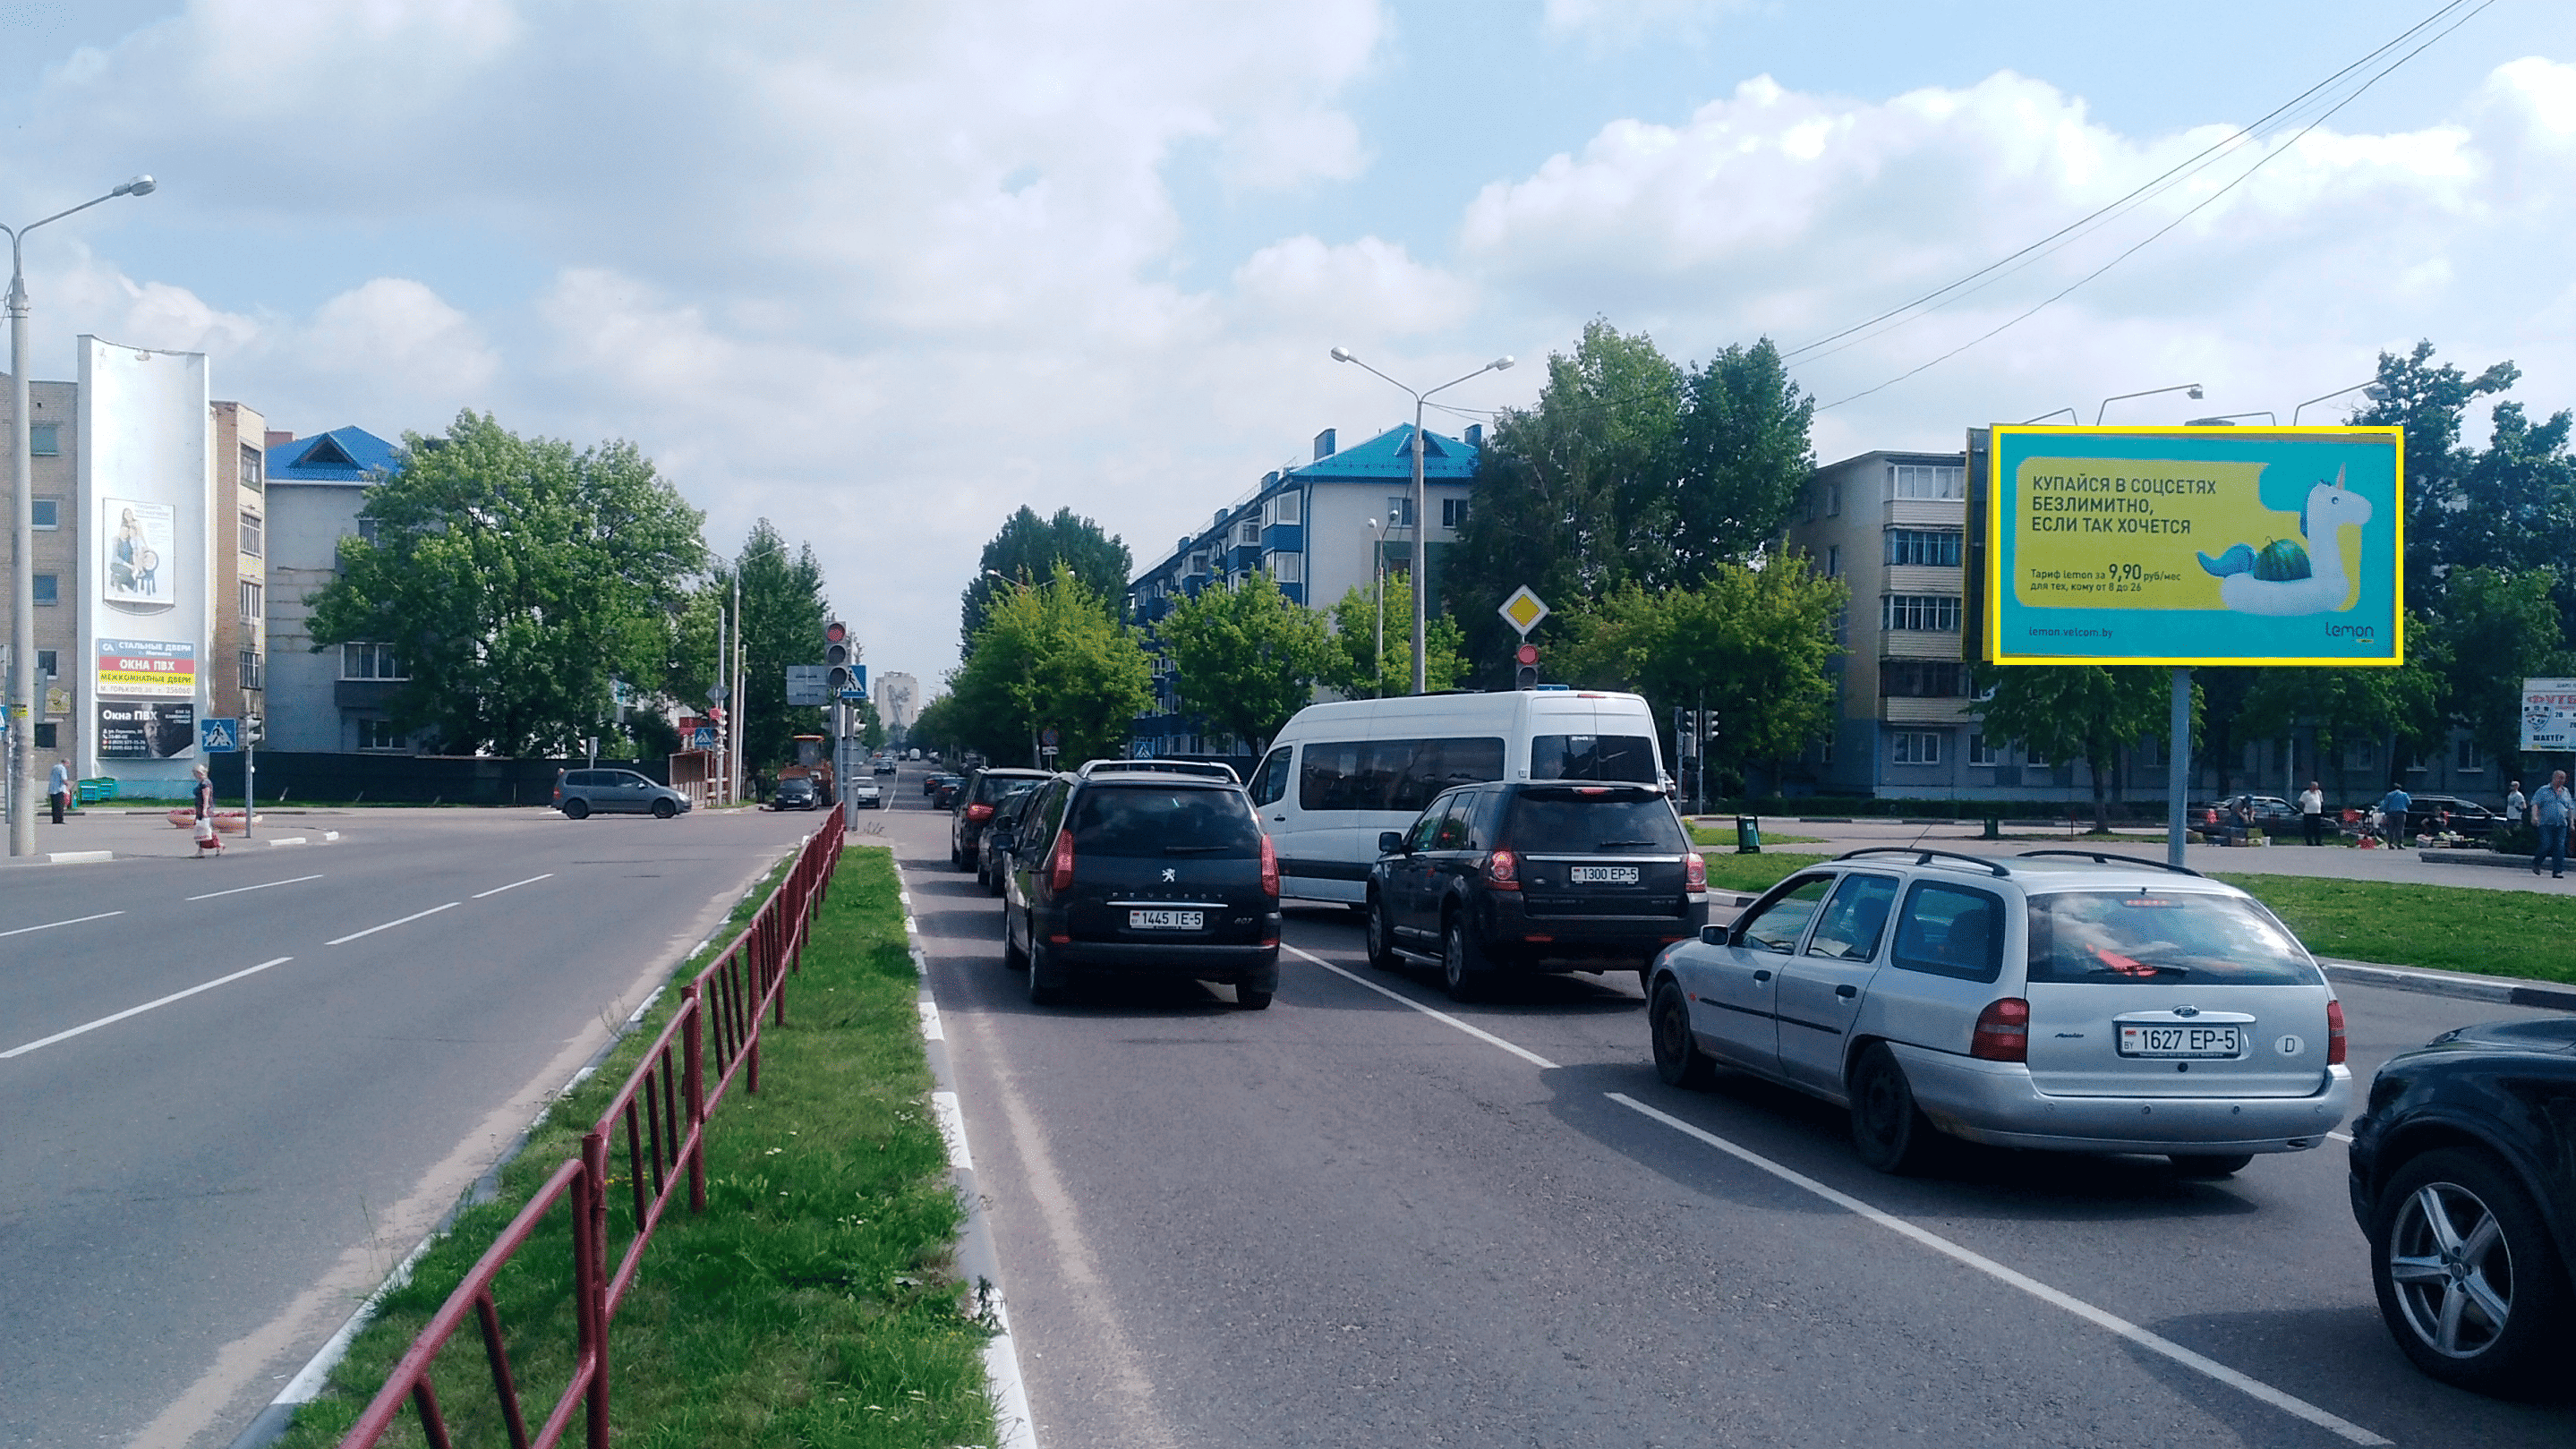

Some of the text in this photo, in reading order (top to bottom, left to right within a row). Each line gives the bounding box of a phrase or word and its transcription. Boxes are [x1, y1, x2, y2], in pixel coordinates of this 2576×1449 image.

[2033, 473, 2216, 496] КУПАЙСЯ В СОЦСЕТЯХ
[2032, 496, 2154, 516] БЕЗЛИМИТНО,
[2032, 516, 2191, 534] ЕСЛИ ТАК ХОЧЕТСЯ
[2030, 564, 2181, 583] Тариф lemon за 9,90 руб/мес
[2030, 583, 2142, 593] для тех, кому от 8 до 26
[2028, 626, 2114, 640] lemon.velcom.by
[2324, 621, 2375, 637] lemon
[165, 644, 192, 652] ДВЕРИ
[119, 659, 175, 671] ОКНА ПВХ
[103, 710, 158, 720] Окна ПВХ
[1582, 868, 1608, 880] 1300
[1610, 868, 1637, 880] EP-5
[1142, 912, 1169, 925] 1445
[1175, 913, 1201, 925] IE-5
[2124, 1030, 2236, 1051] BY 1627 EP-5
[2284, 1037, 2295, 1053] D
